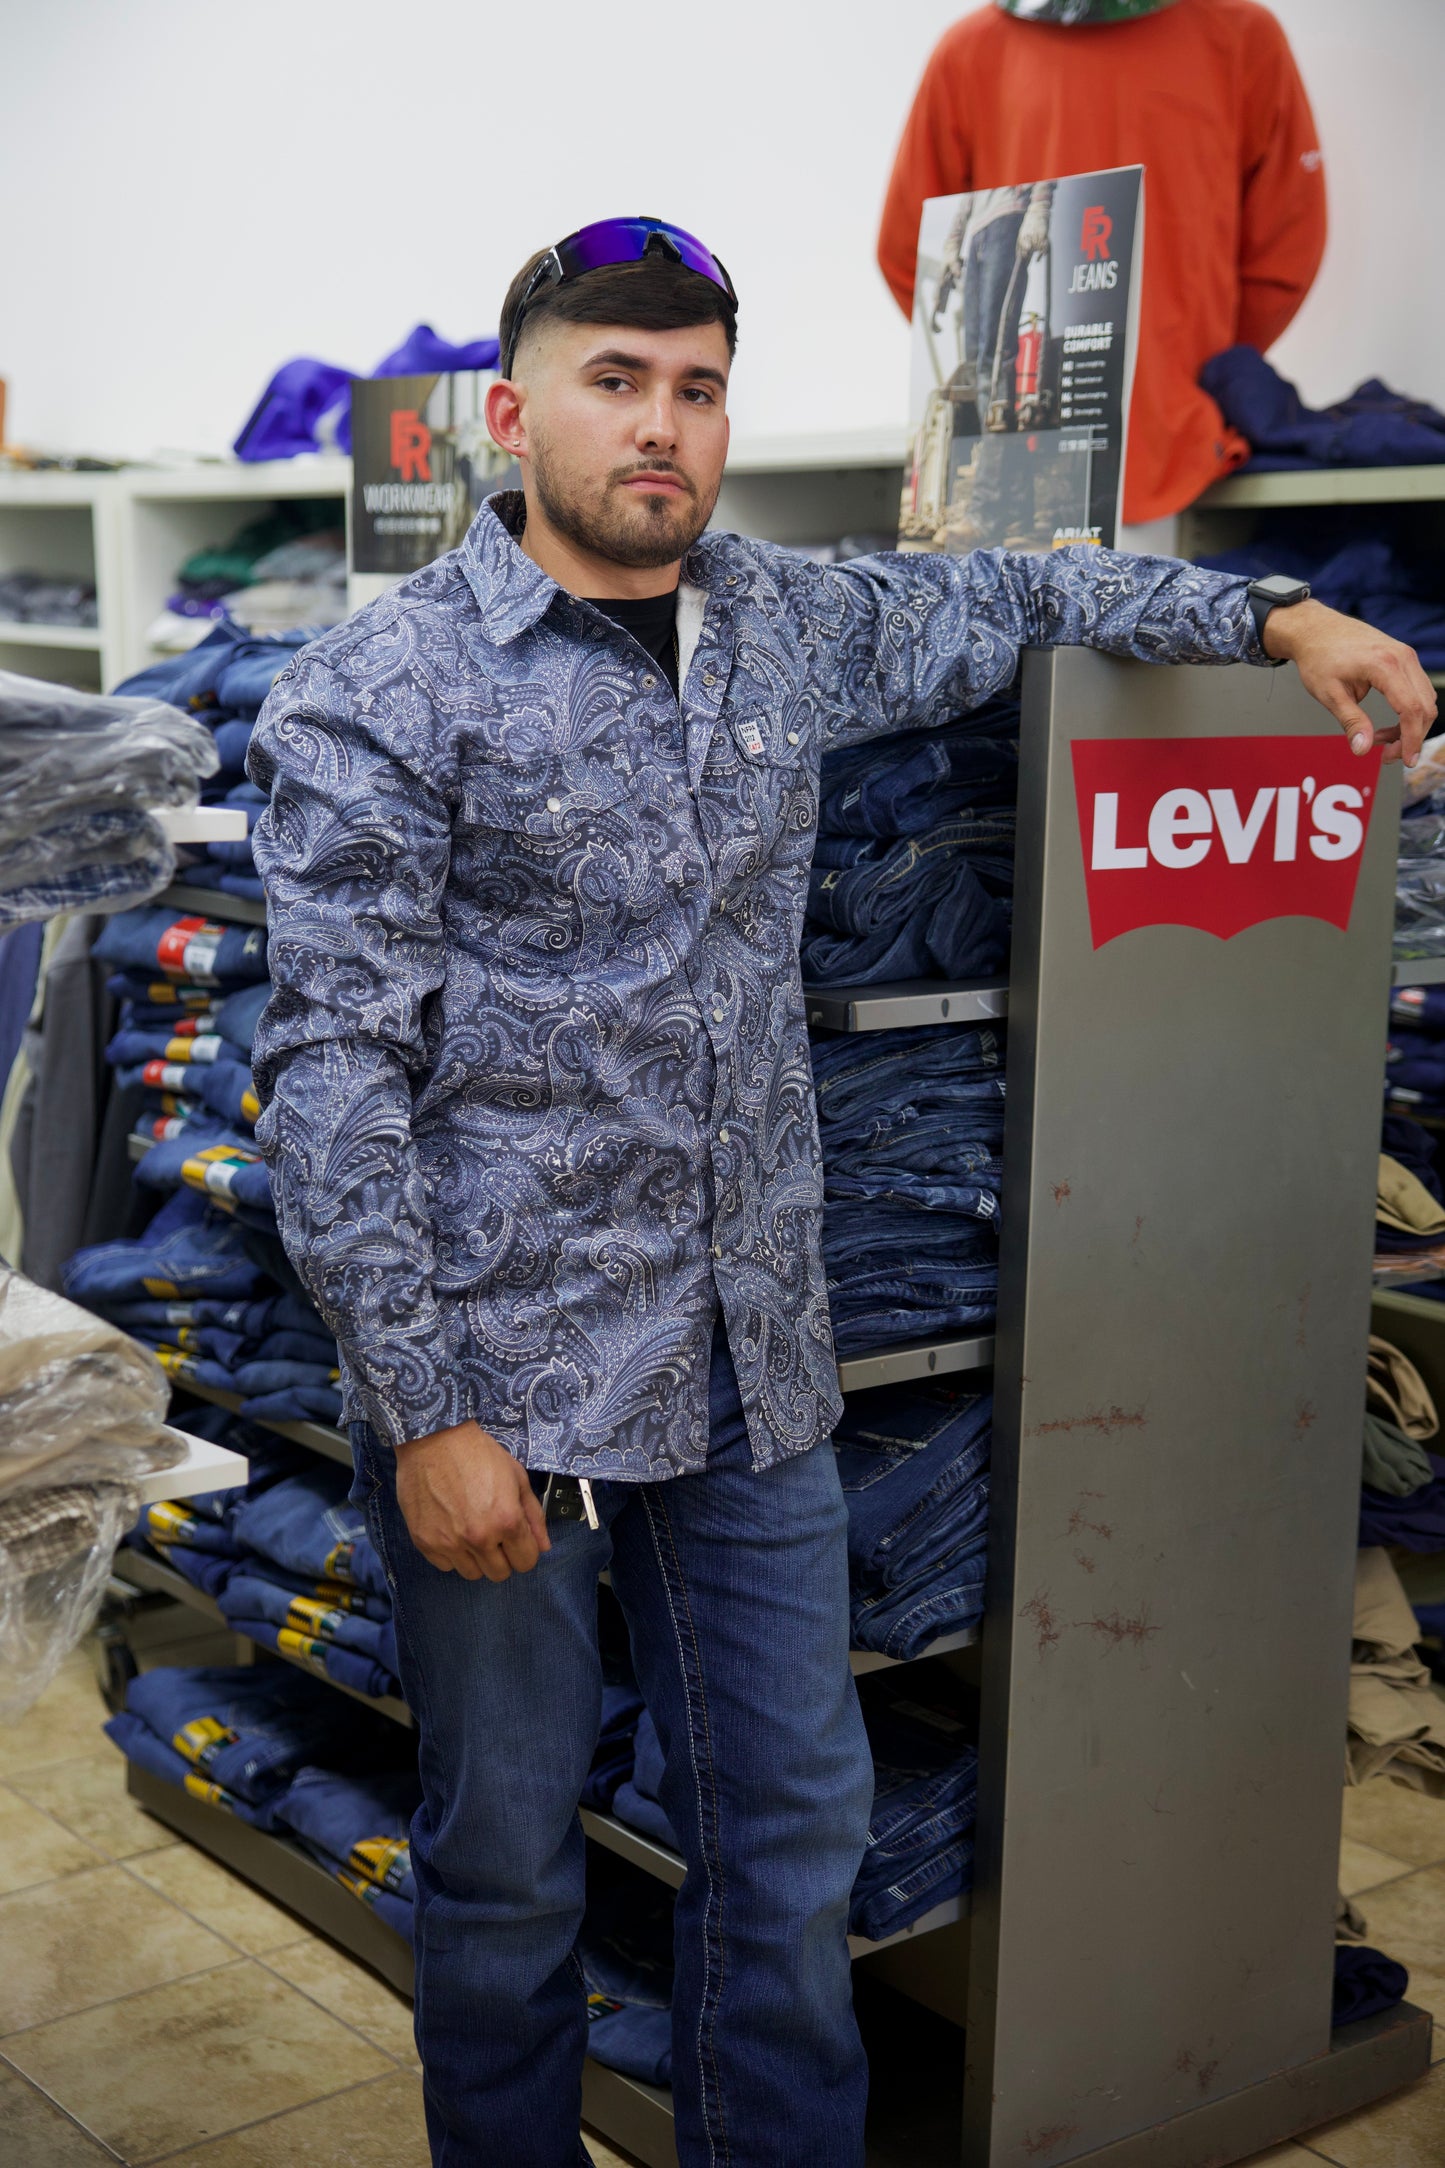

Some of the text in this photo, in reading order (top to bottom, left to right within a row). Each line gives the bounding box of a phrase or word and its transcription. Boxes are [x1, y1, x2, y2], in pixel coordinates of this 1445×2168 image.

[1069, 261, 1118, 293] JEANS
[1064, 322, 1112, 339] DURABLE
[1063, 337, 1112, 353] COMFORT
[364, 484, 454, 513] WORKWEAR
[1053, 527, 1102, 538] ARIAT
